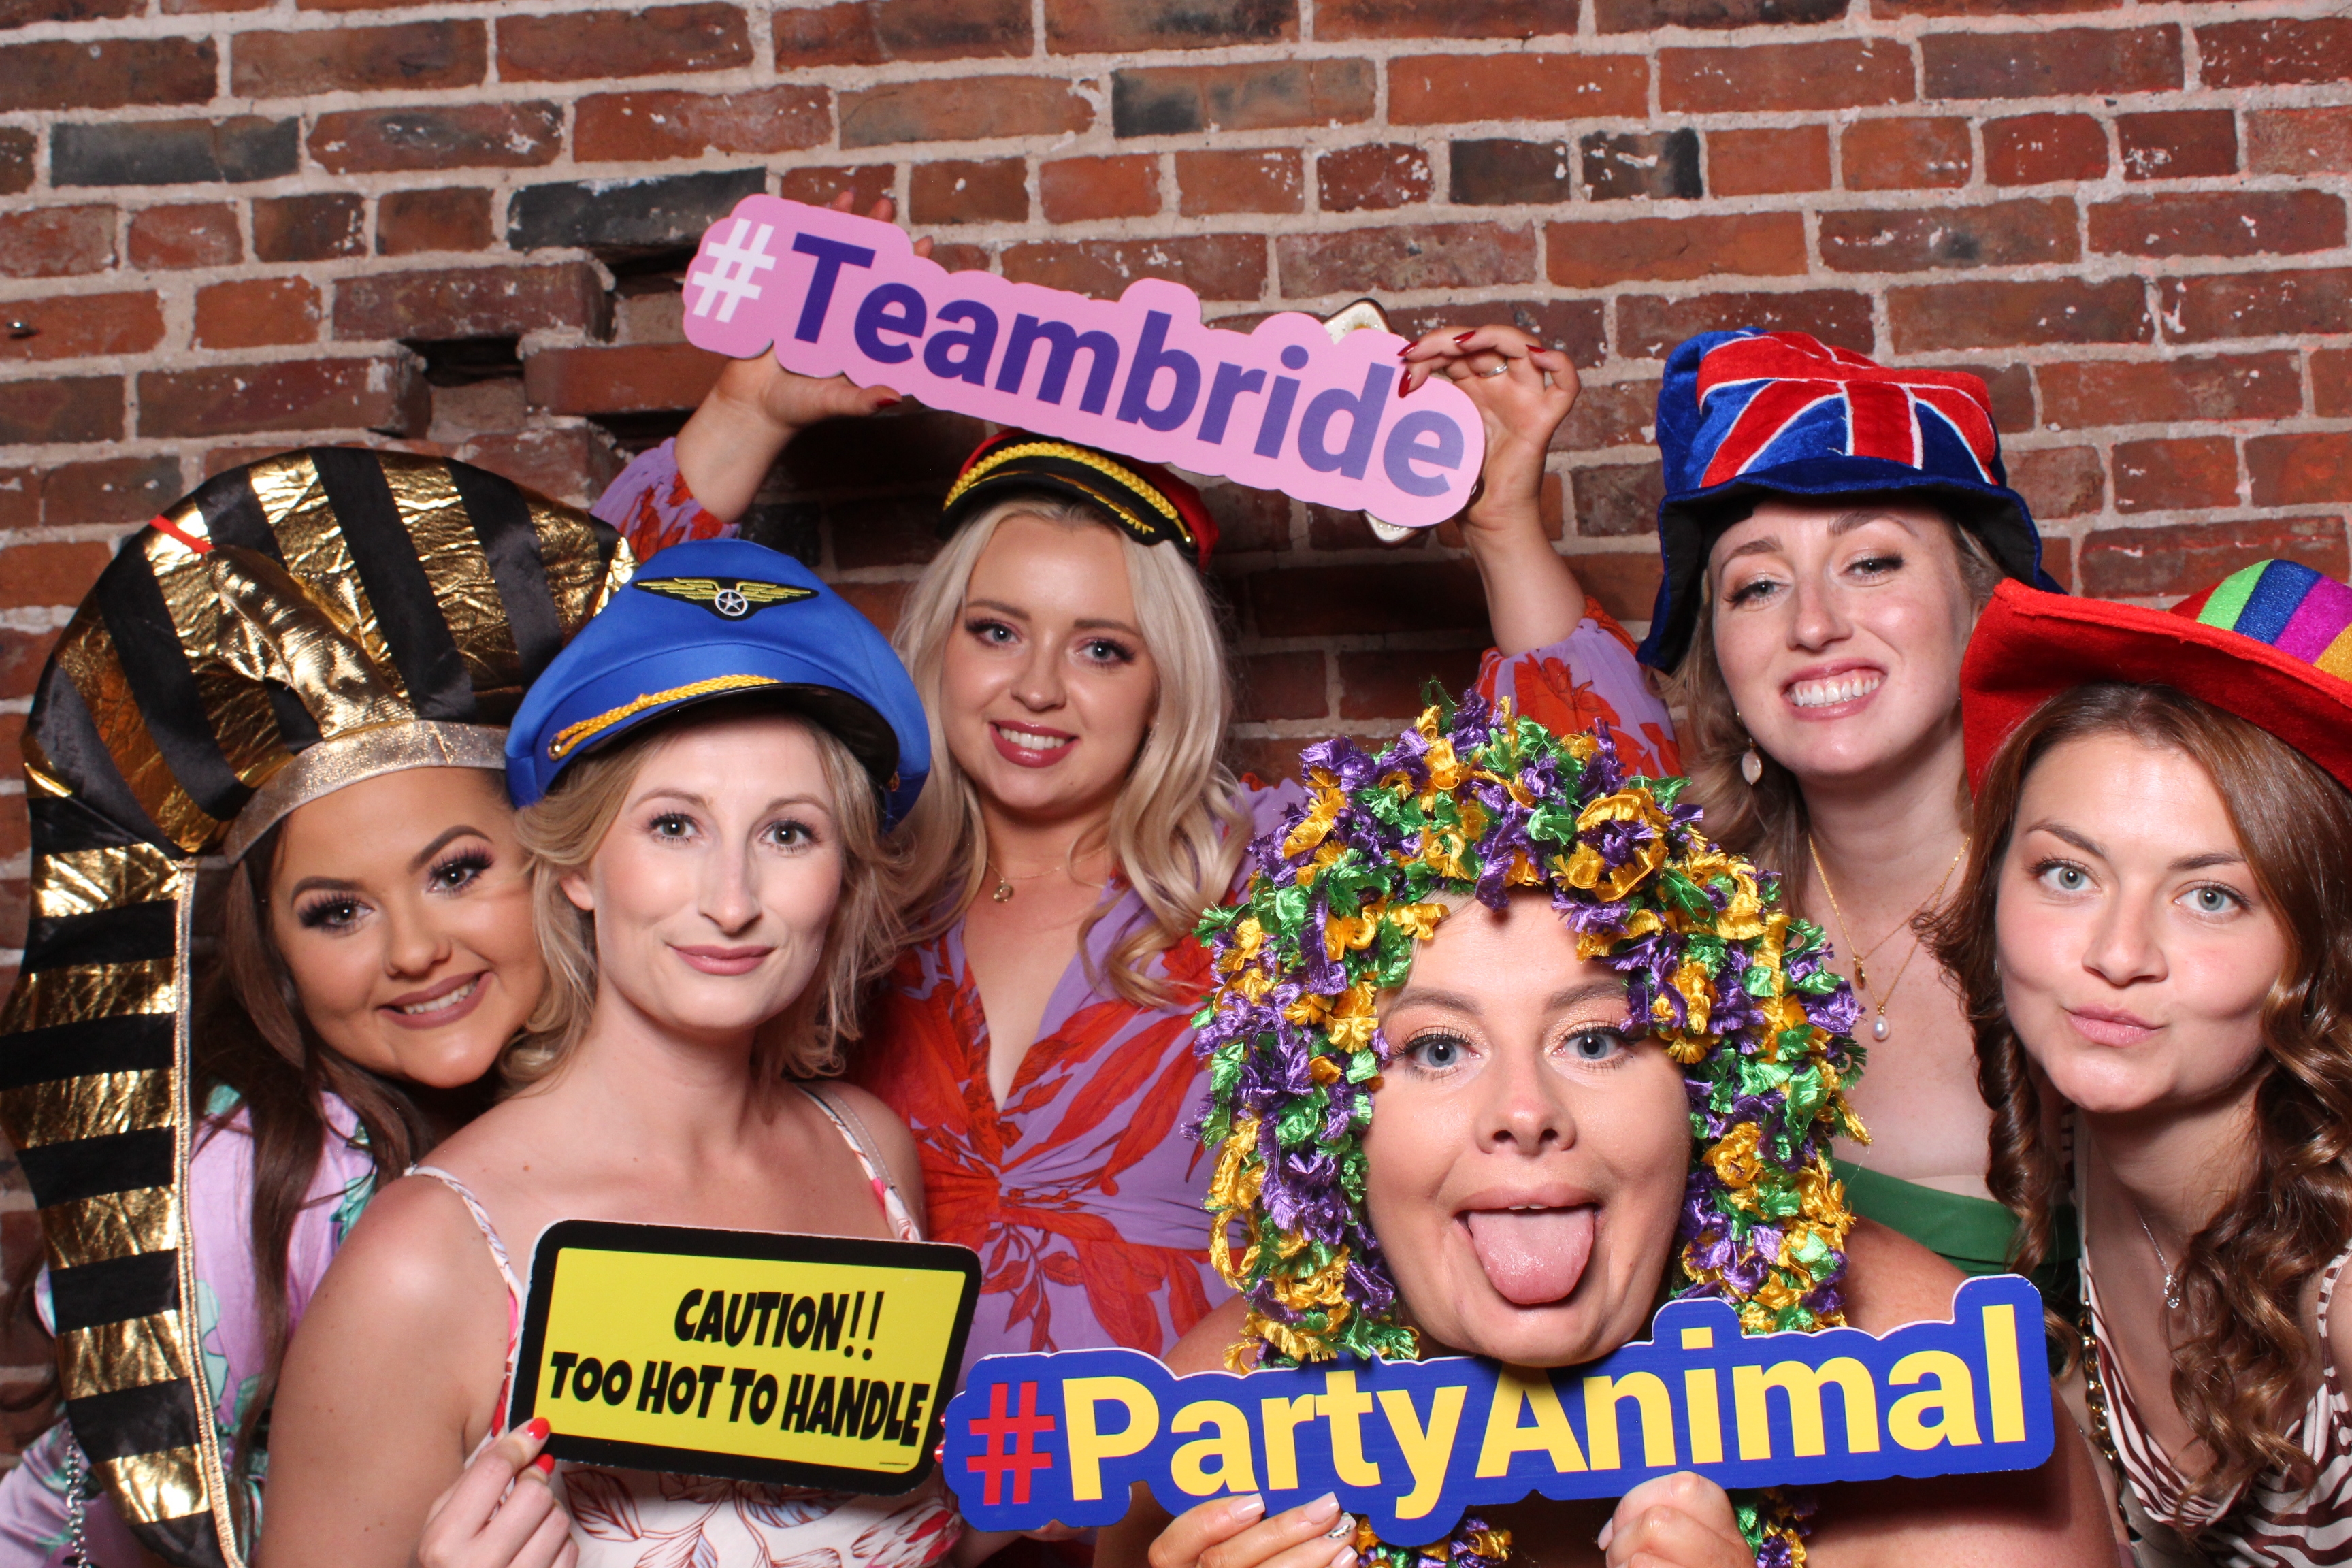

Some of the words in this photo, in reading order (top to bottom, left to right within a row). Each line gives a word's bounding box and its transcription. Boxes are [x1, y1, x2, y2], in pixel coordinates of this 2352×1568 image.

[691, 218, 1465, 497] #Teambride
[550, 1351, 632, 1406] TOO
[636, 1360, 725, 1418] HOT
[729, 1368, 778, 1425] TO
[781, 1374, 930, 1446] HANDLE
[674, 1288, 885, 1360] CAUTION!!
[966, 1304, 2026, 1519] #PartyAnimal
